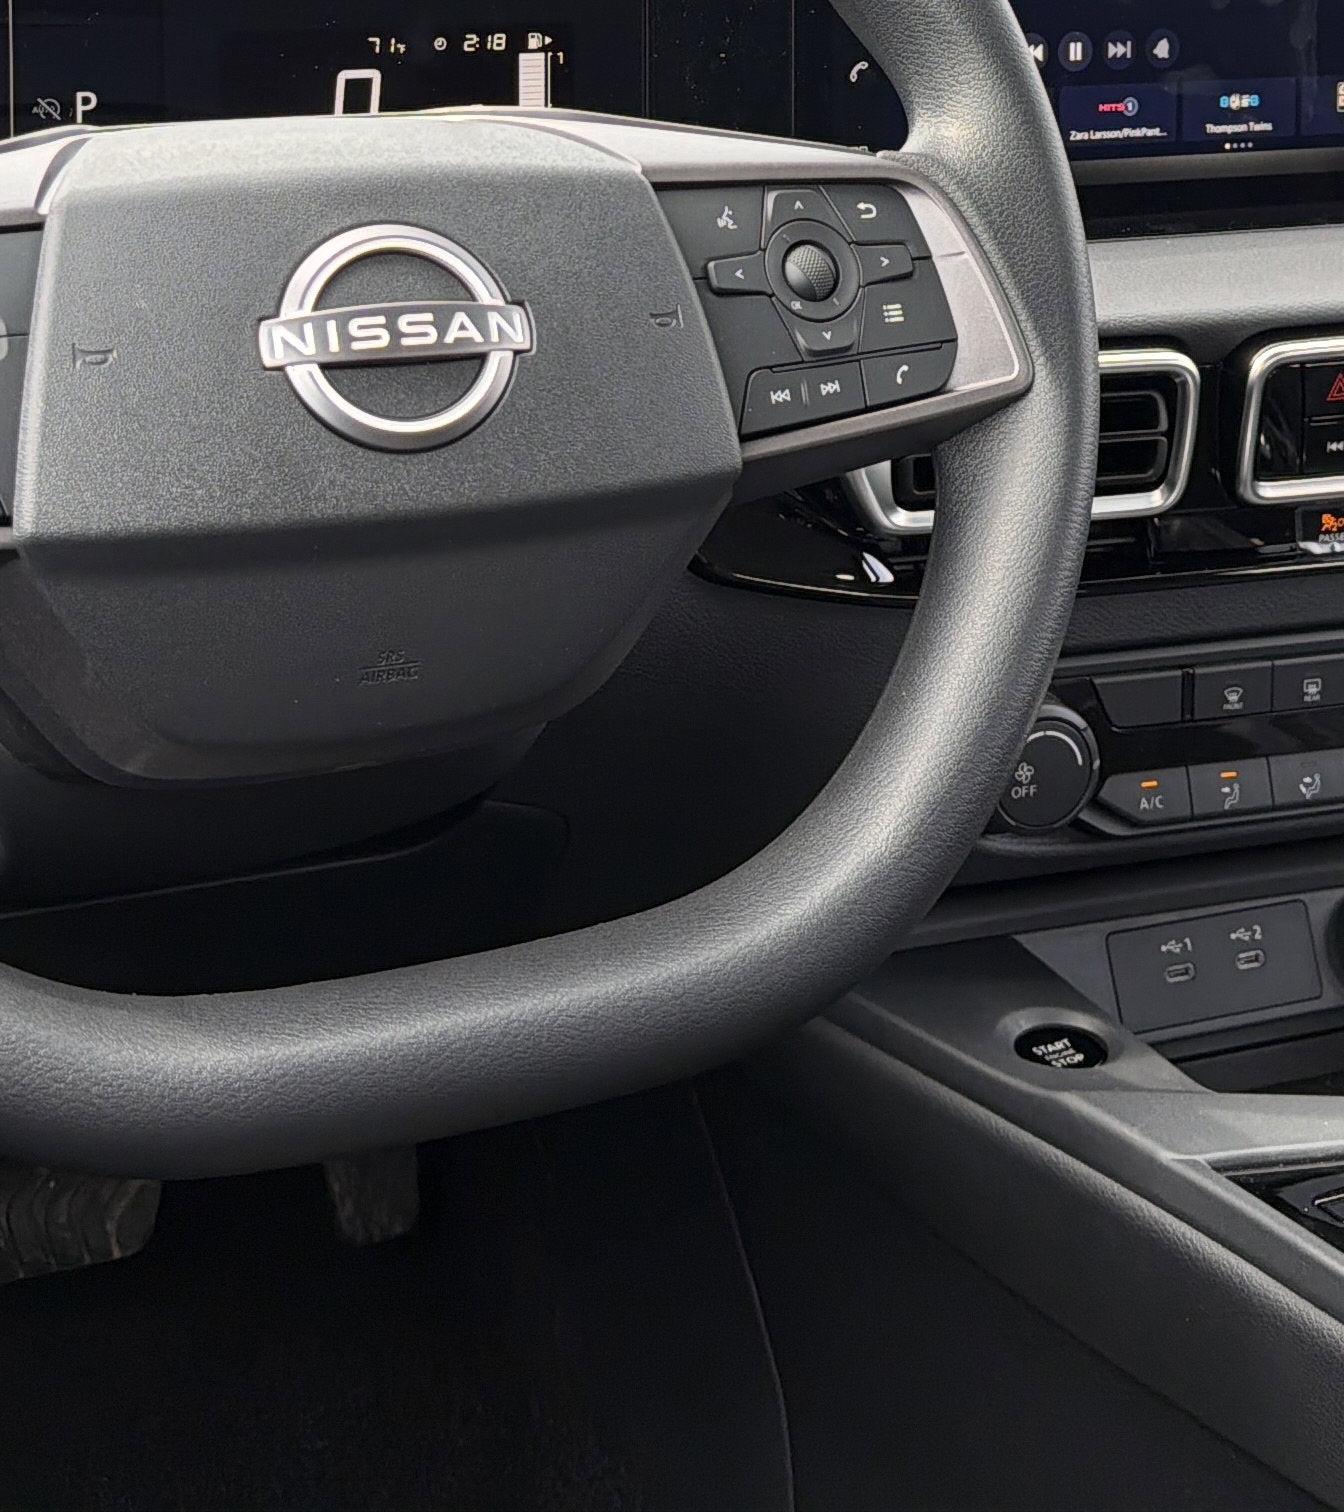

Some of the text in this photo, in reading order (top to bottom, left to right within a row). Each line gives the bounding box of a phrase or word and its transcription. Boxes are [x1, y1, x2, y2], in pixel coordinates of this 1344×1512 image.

[463, 33, 507, 52] 2:18
[76, 91, 97, 124] P
[1069, 130, 1089, 141] Zara
[1205, 123, 1248, 135] Thompson
[271, 311, 524, 360] NISSAN
[1011, 784, 1038, 799] OFF
[1139, 795, 1165, 810] A/C
[1031, 1037, 1072, 1056] START
[1051, 1053, 1085, 1068] STOP
